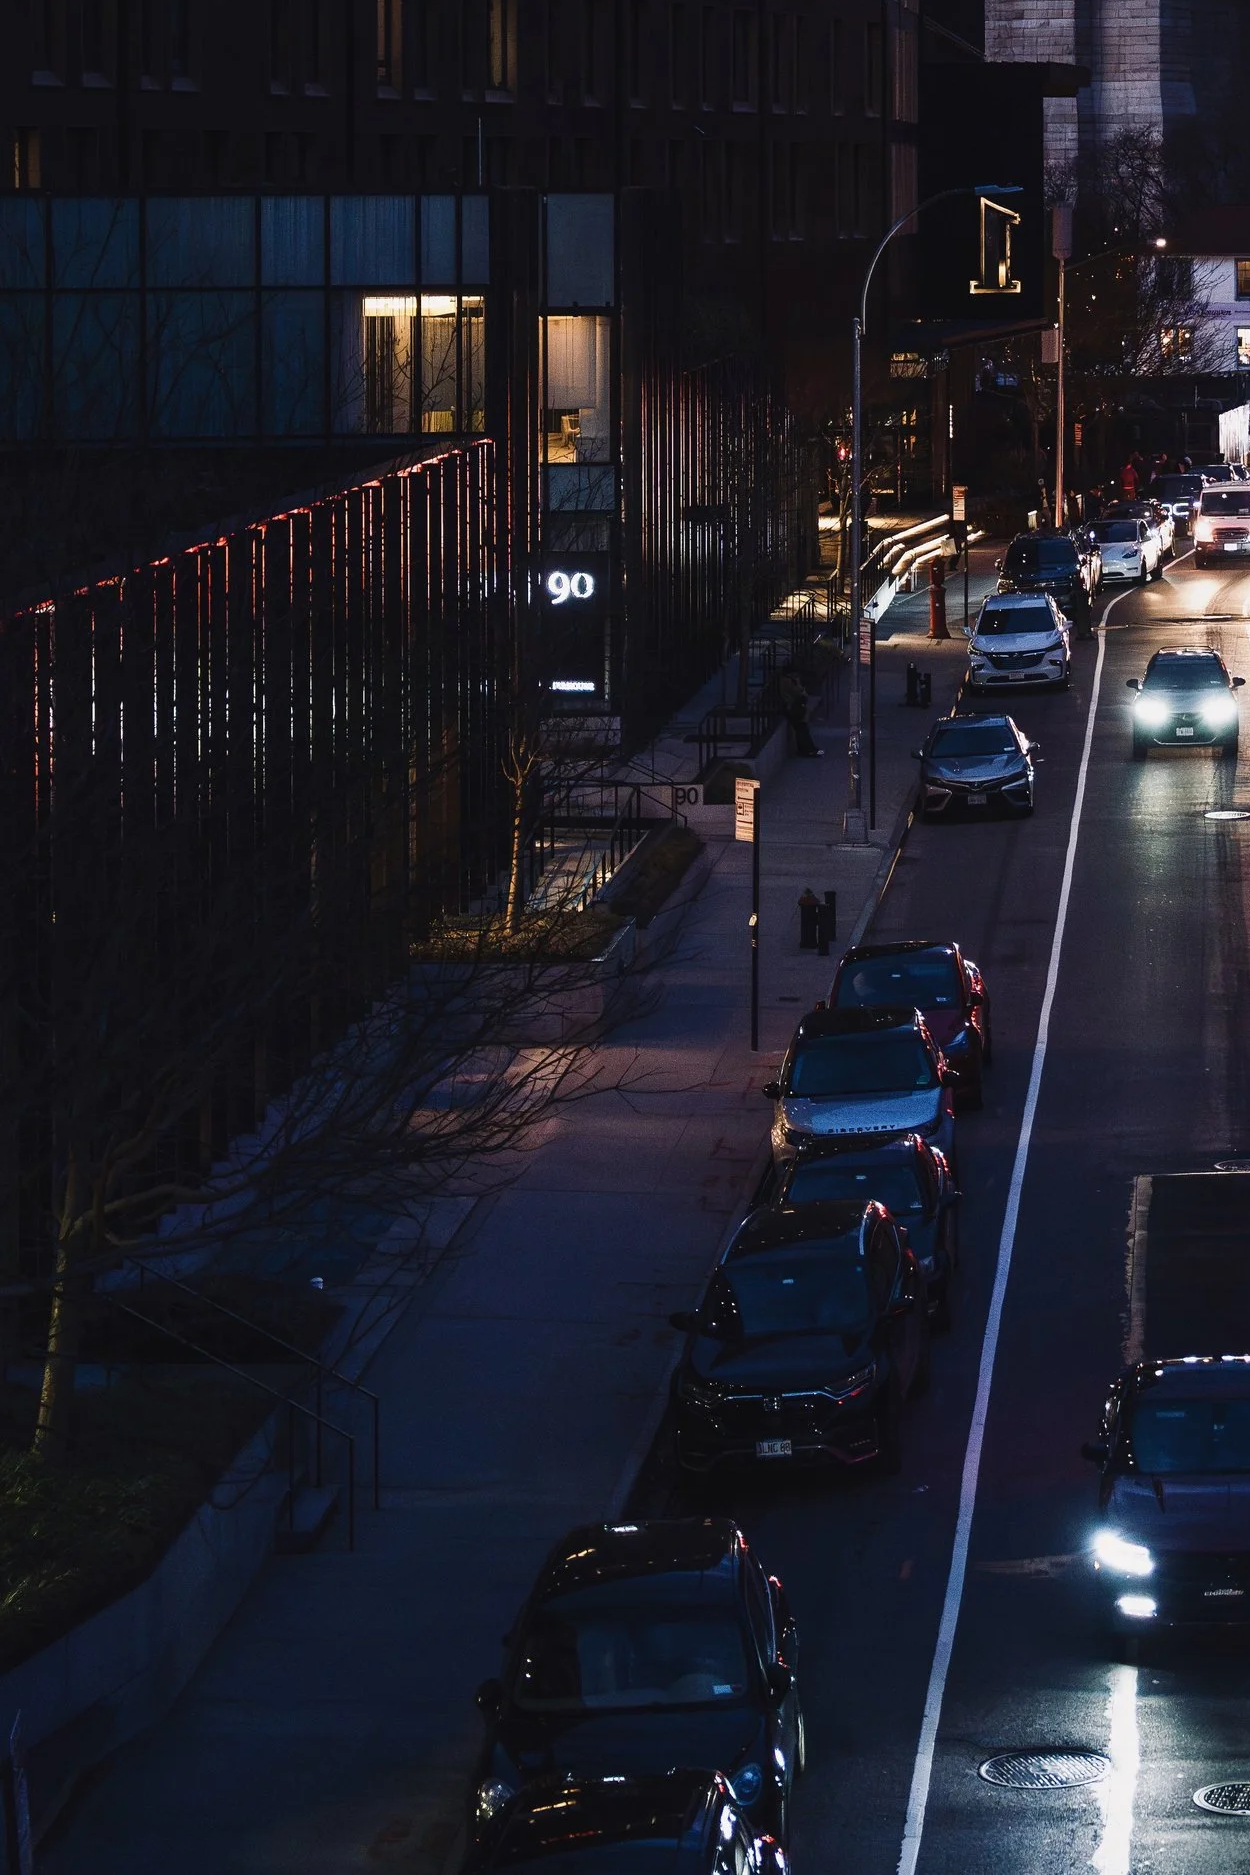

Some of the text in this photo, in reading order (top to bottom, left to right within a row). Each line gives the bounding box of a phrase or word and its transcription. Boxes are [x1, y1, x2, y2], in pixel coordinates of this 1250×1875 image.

[548, 571, 595, 605] 90
[675, 786, 699, 806] 90
[827, 1124, 896, 1134] DISCOVERY
